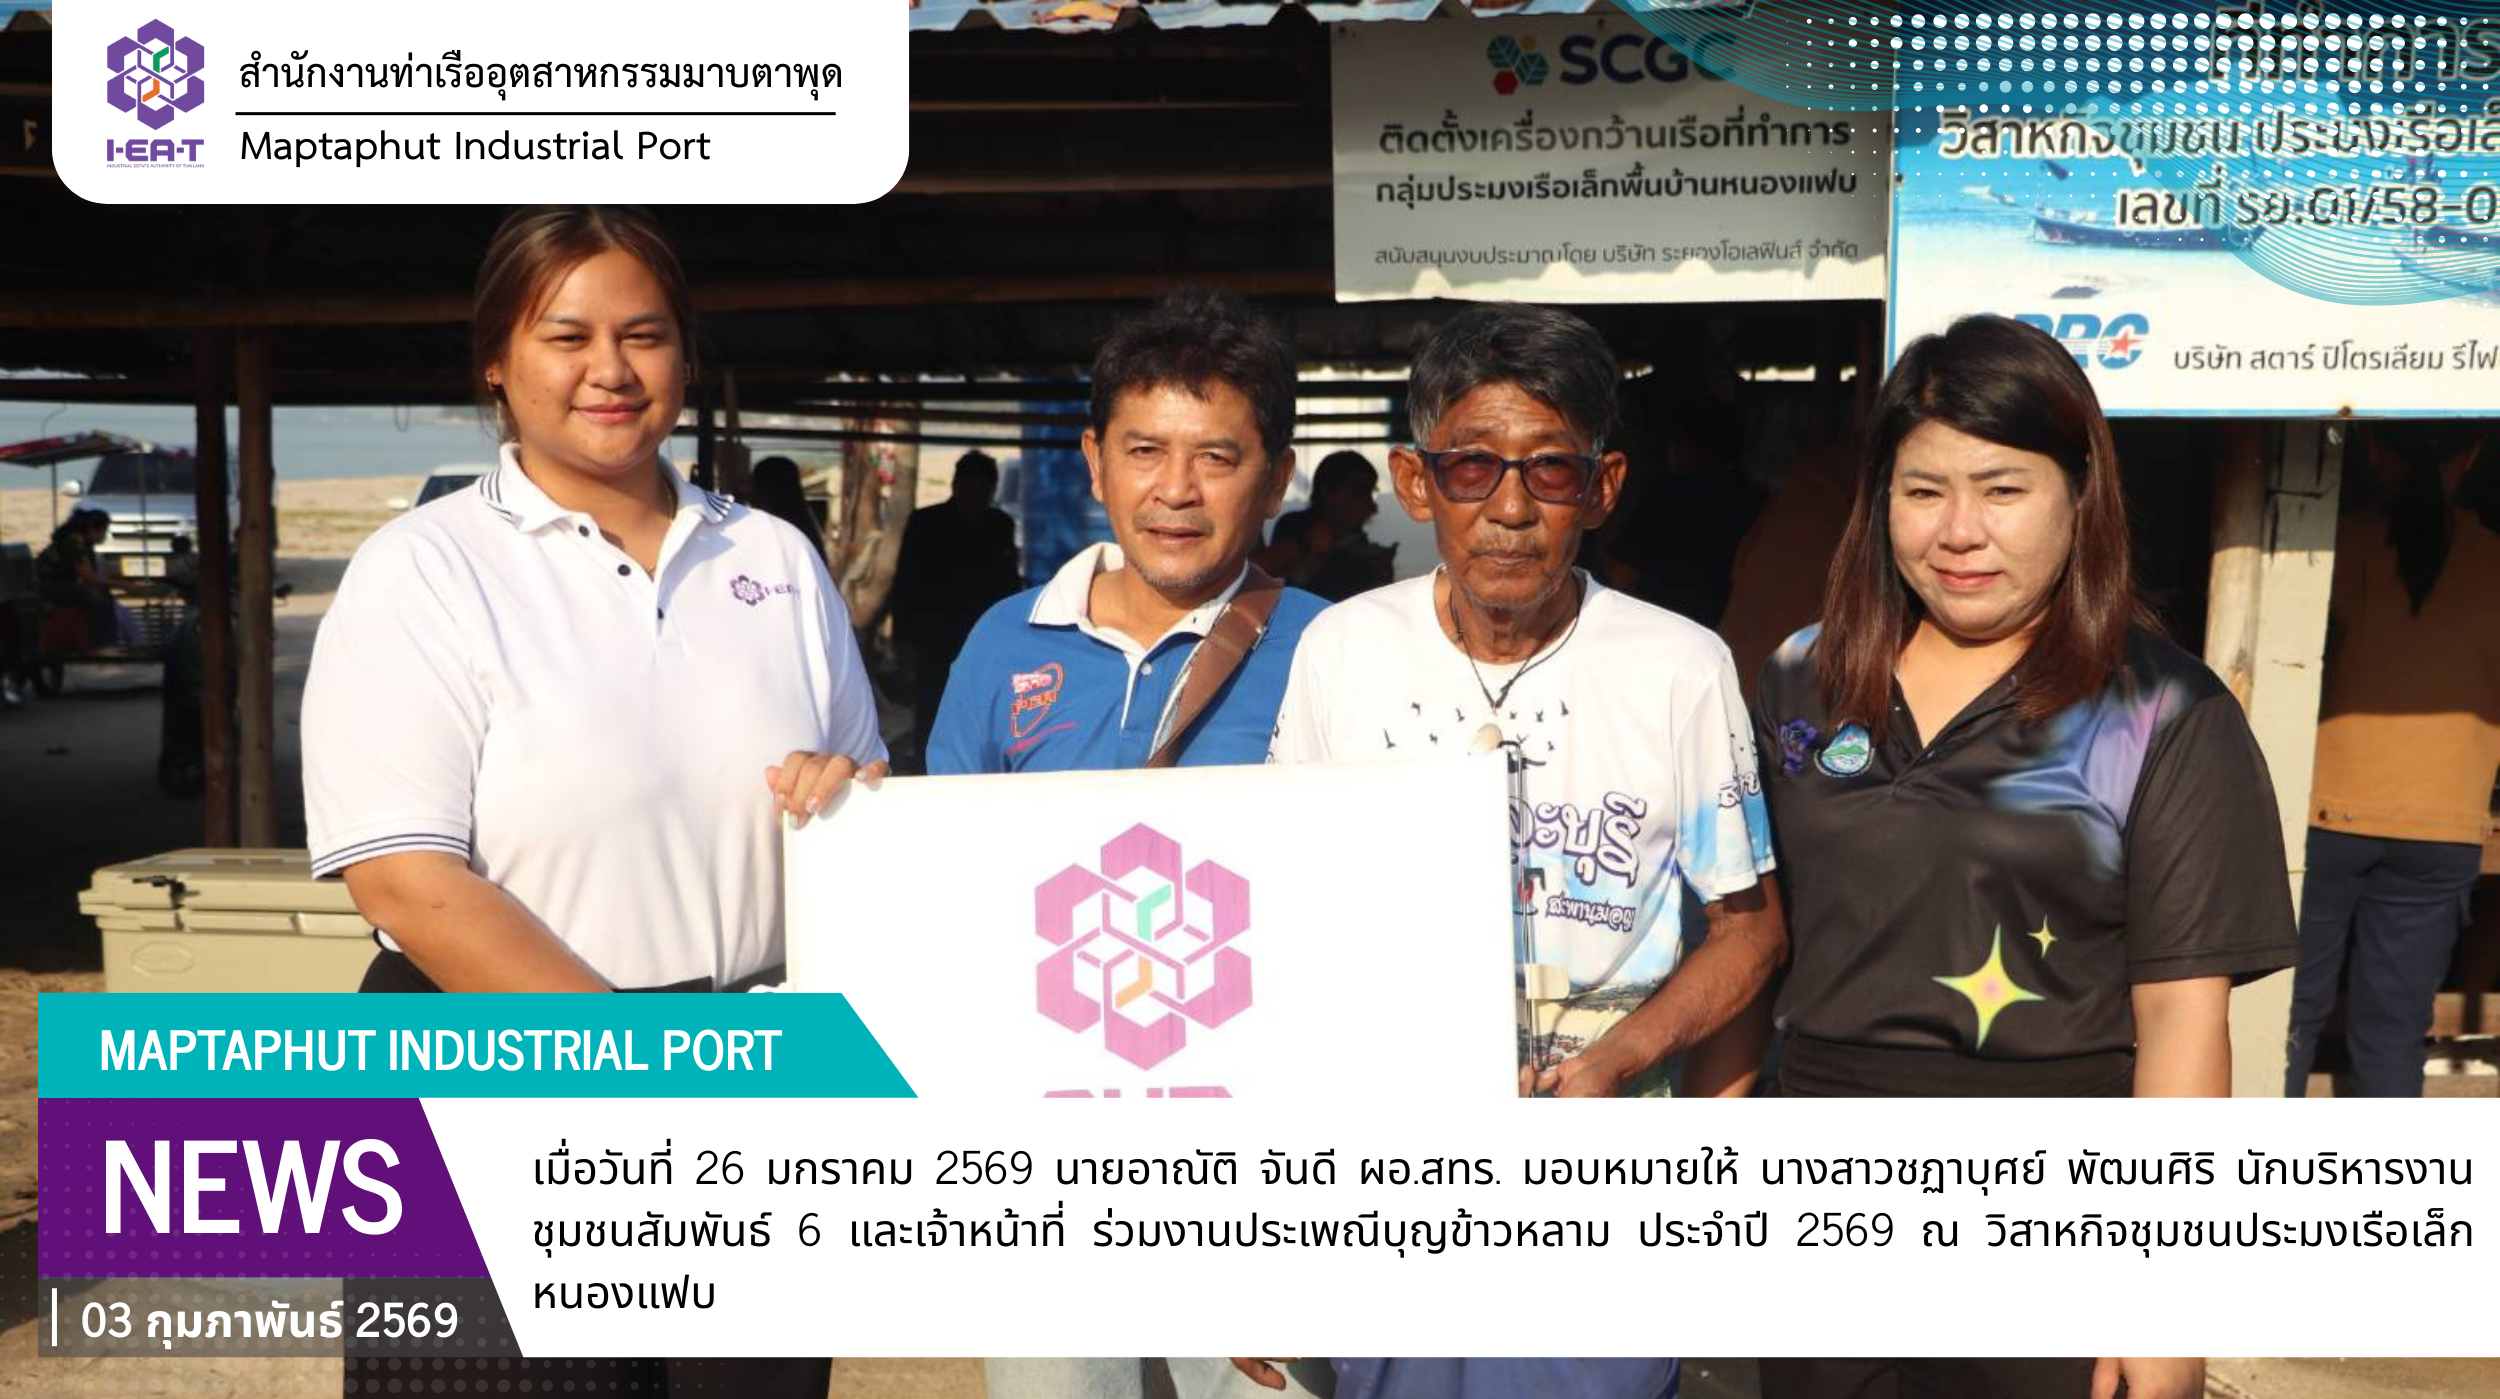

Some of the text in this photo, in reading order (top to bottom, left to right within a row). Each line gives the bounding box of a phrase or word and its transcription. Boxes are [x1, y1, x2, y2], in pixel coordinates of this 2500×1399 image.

[1559, 32, 1737, 85] SCGC
[1379, 106, 1850, 155] ติดตั้งเครื่องกว้านเรือที่ทำการ
[1941, 110, 2240, 172] วิสาหกิจชุมชน
[1375, 162, 1857, 210] กลุ่มประมงเรือเล็กพื้นบ้านหนองแฟบ
[2118, 164, 2222, 225] เลขที่
[1603, 243, 1656, 264] บริษัท
[1809, 239, 1859, 259] จำกัด
[2174, 344, 2242, 370] บริษัท
[2249, 343, 2315, 370] สตาร์
[2322, 339, 2444, 370] ปิโตรเลียม
